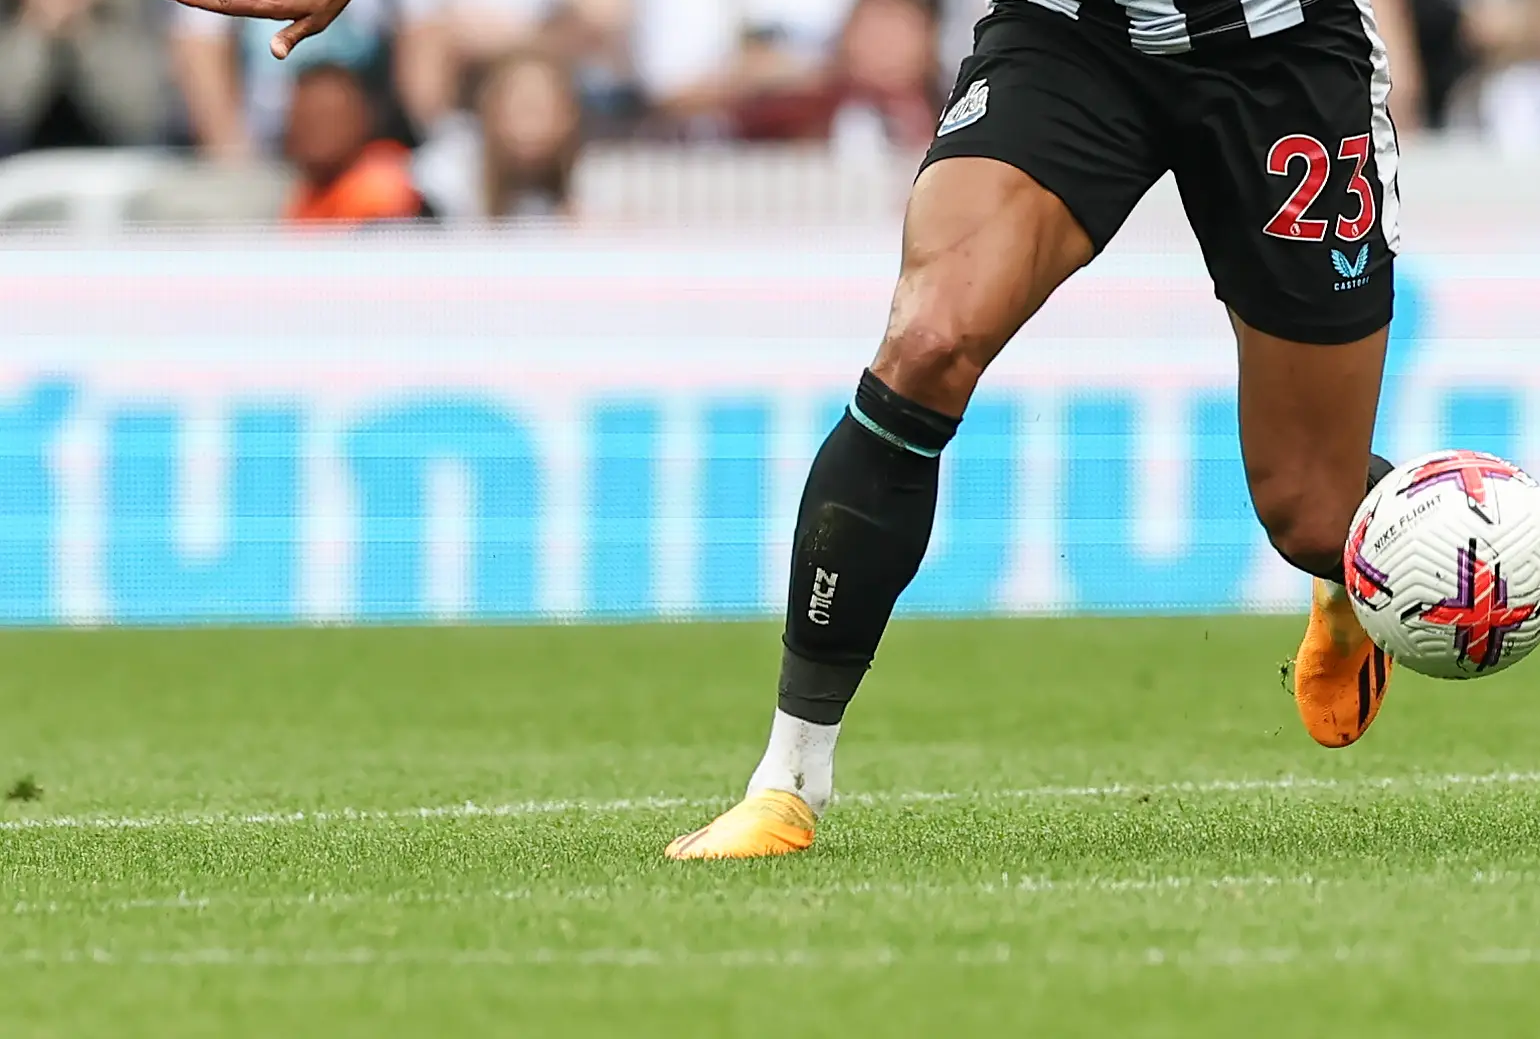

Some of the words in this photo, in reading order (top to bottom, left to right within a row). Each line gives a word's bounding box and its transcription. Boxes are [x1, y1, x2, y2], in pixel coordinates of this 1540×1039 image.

[1262, 132, 1376, 242] 23
[1373, 524, 1397, 553] NIKE
[1399, 493, 1442, 528] FLIGHT
[808, 567, 839, 626] NUFC
